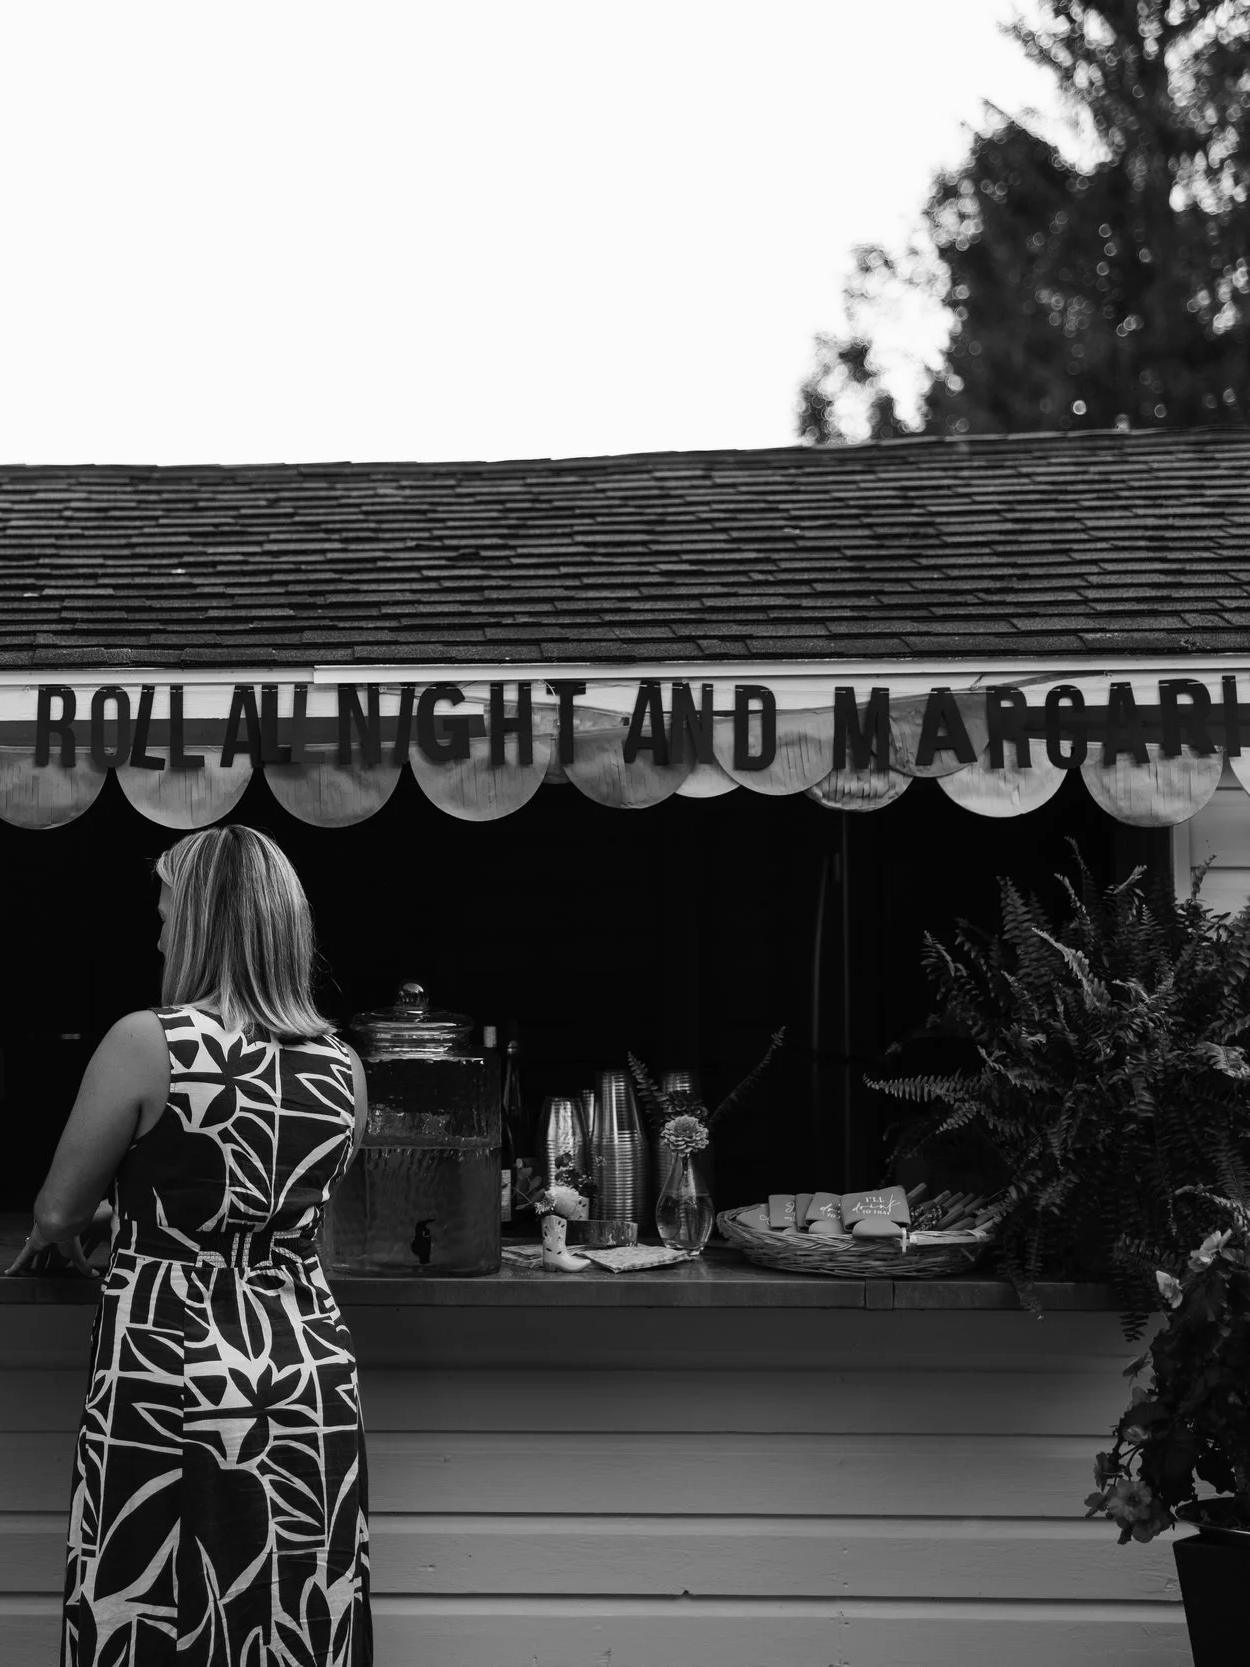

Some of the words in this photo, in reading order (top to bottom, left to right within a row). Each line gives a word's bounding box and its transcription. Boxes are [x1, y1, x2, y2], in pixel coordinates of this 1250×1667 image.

[35, 684, 205, 770] ROLL
[220, 685, 325, 768] ALL
[337, 681, 586, 767] NIGHT
[623, 680, 777, 771] AND
